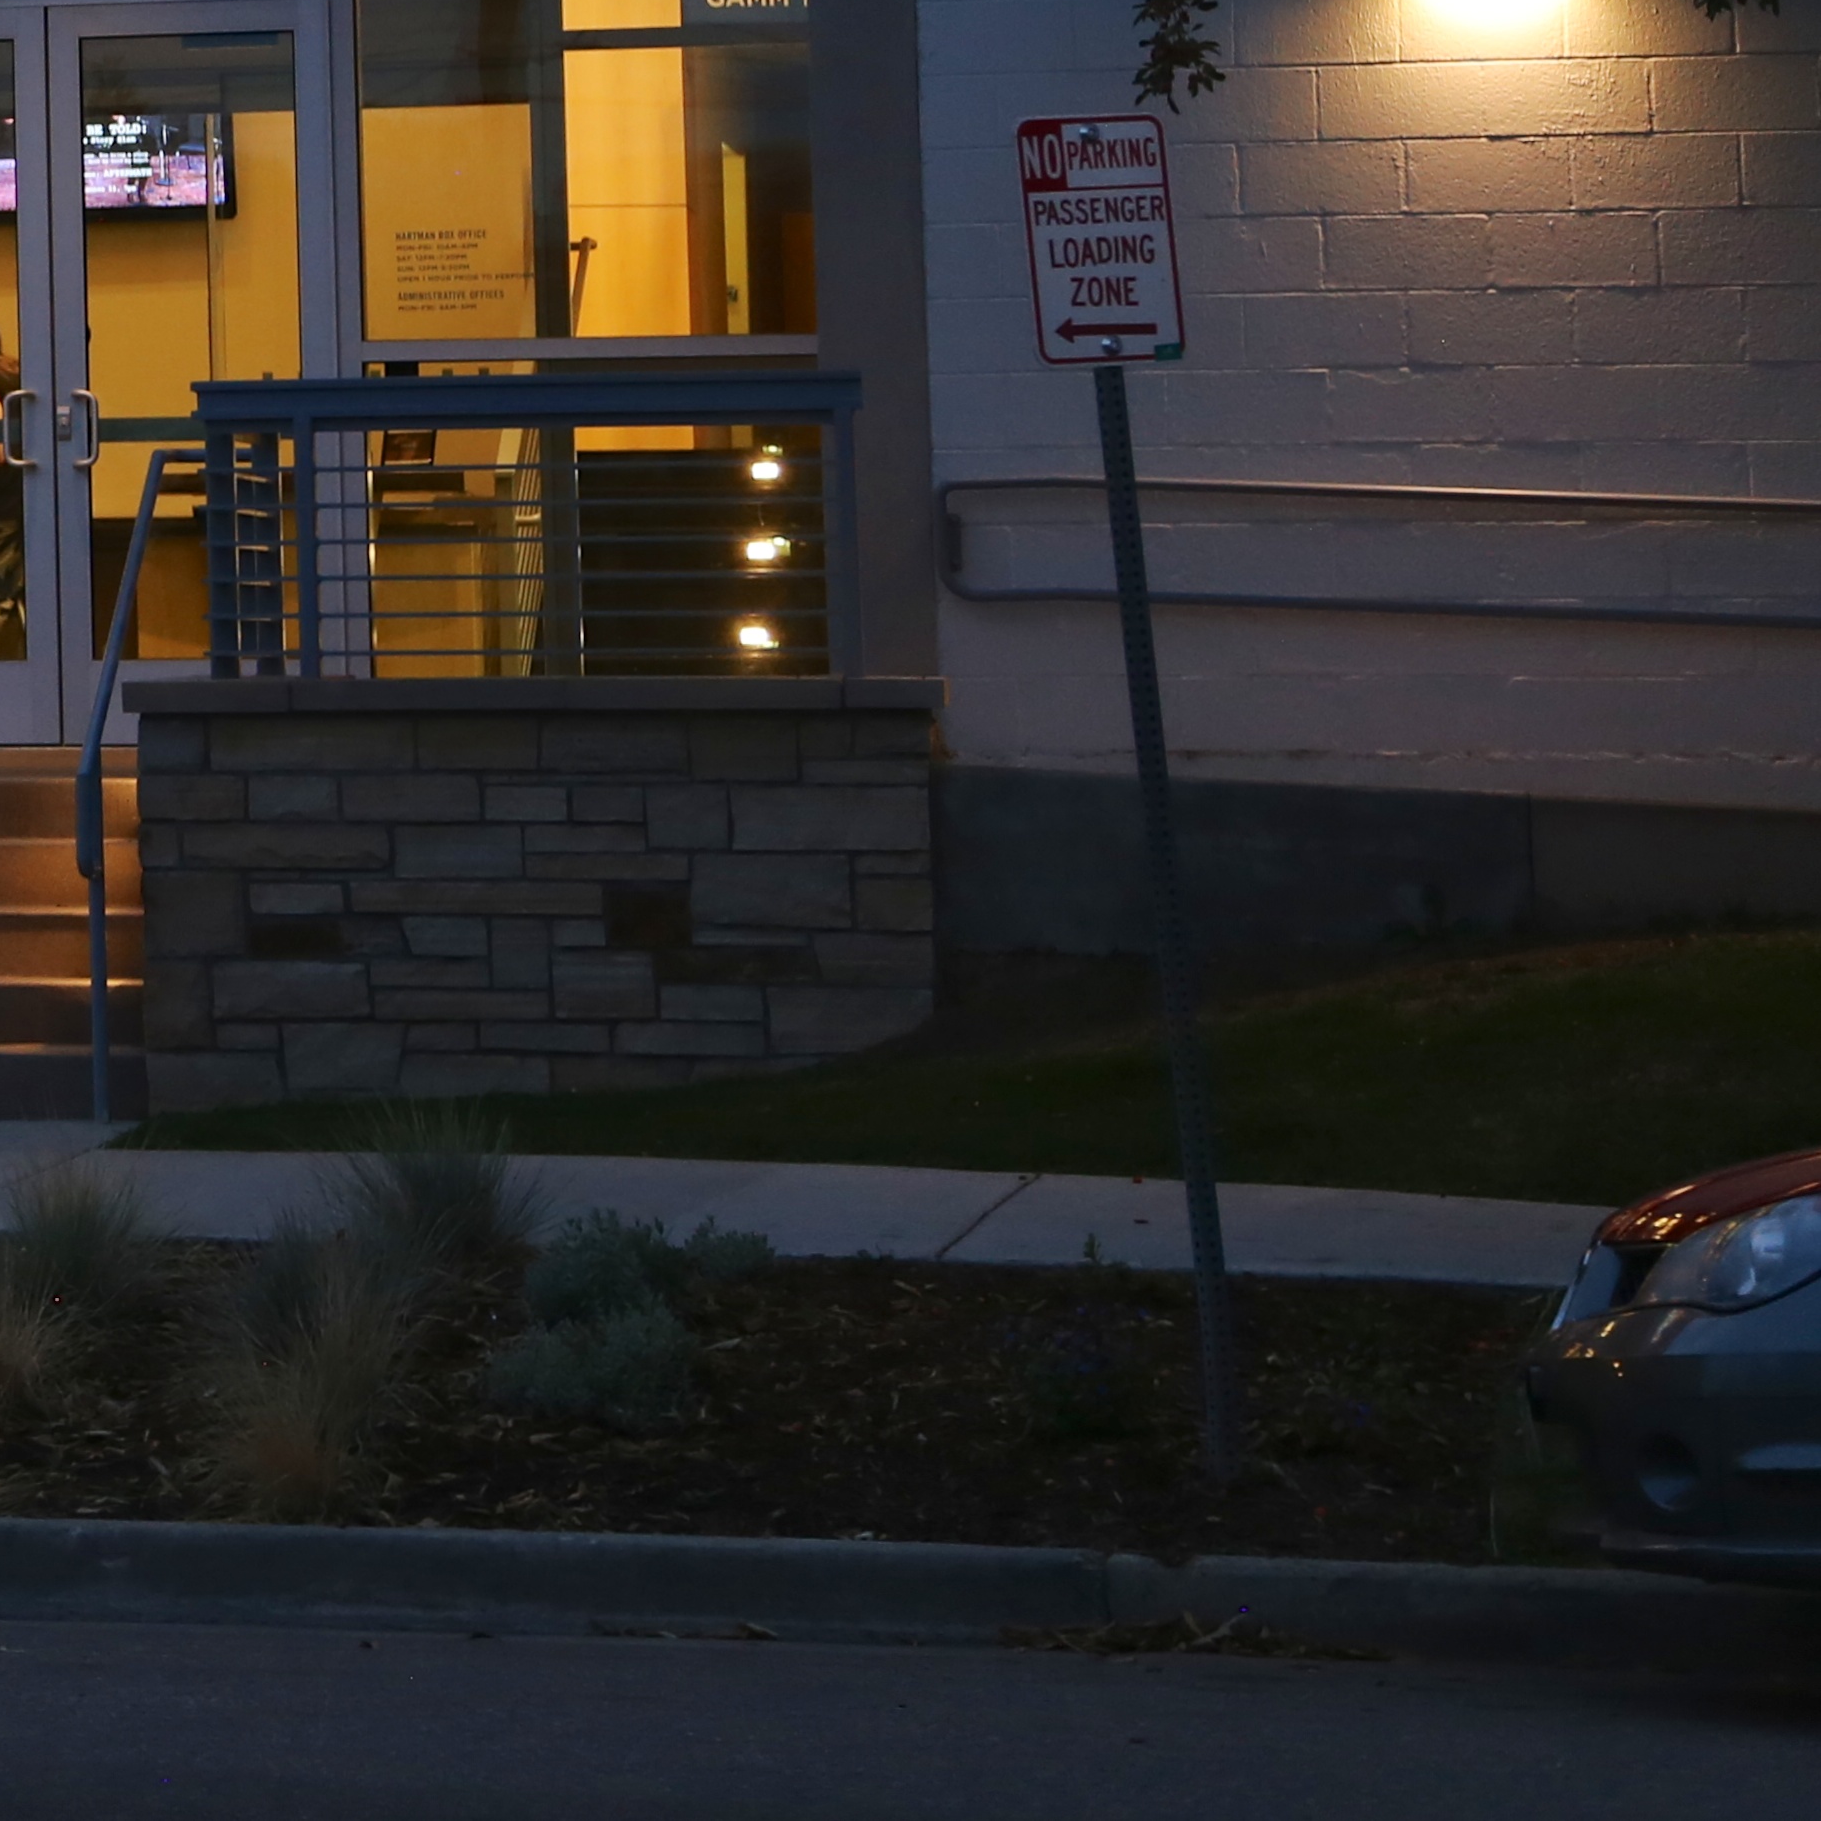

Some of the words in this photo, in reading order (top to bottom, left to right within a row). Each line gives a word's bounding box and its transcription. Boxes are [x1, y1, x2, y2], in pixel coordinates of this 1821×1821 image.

[86, 124, 104, 136] BE
[1021, 134, 1062, 179] NO
[1067, 138, 1157, 170] PARKING
[1033, 195, 1165, 226] PASSENGER
[395, 232, 436, 241] HARTMAN
[438, 231, 454, 240] BOX
[458, 229, 487, 239] OFFICE
[1049, 234, 1156, 269] LOADING
[398, 290, 466, 301] ADMINISTRATIVE
[469, 289, 505, 300] OFFICES
[1070, 277, 1139, 307] ZONE
